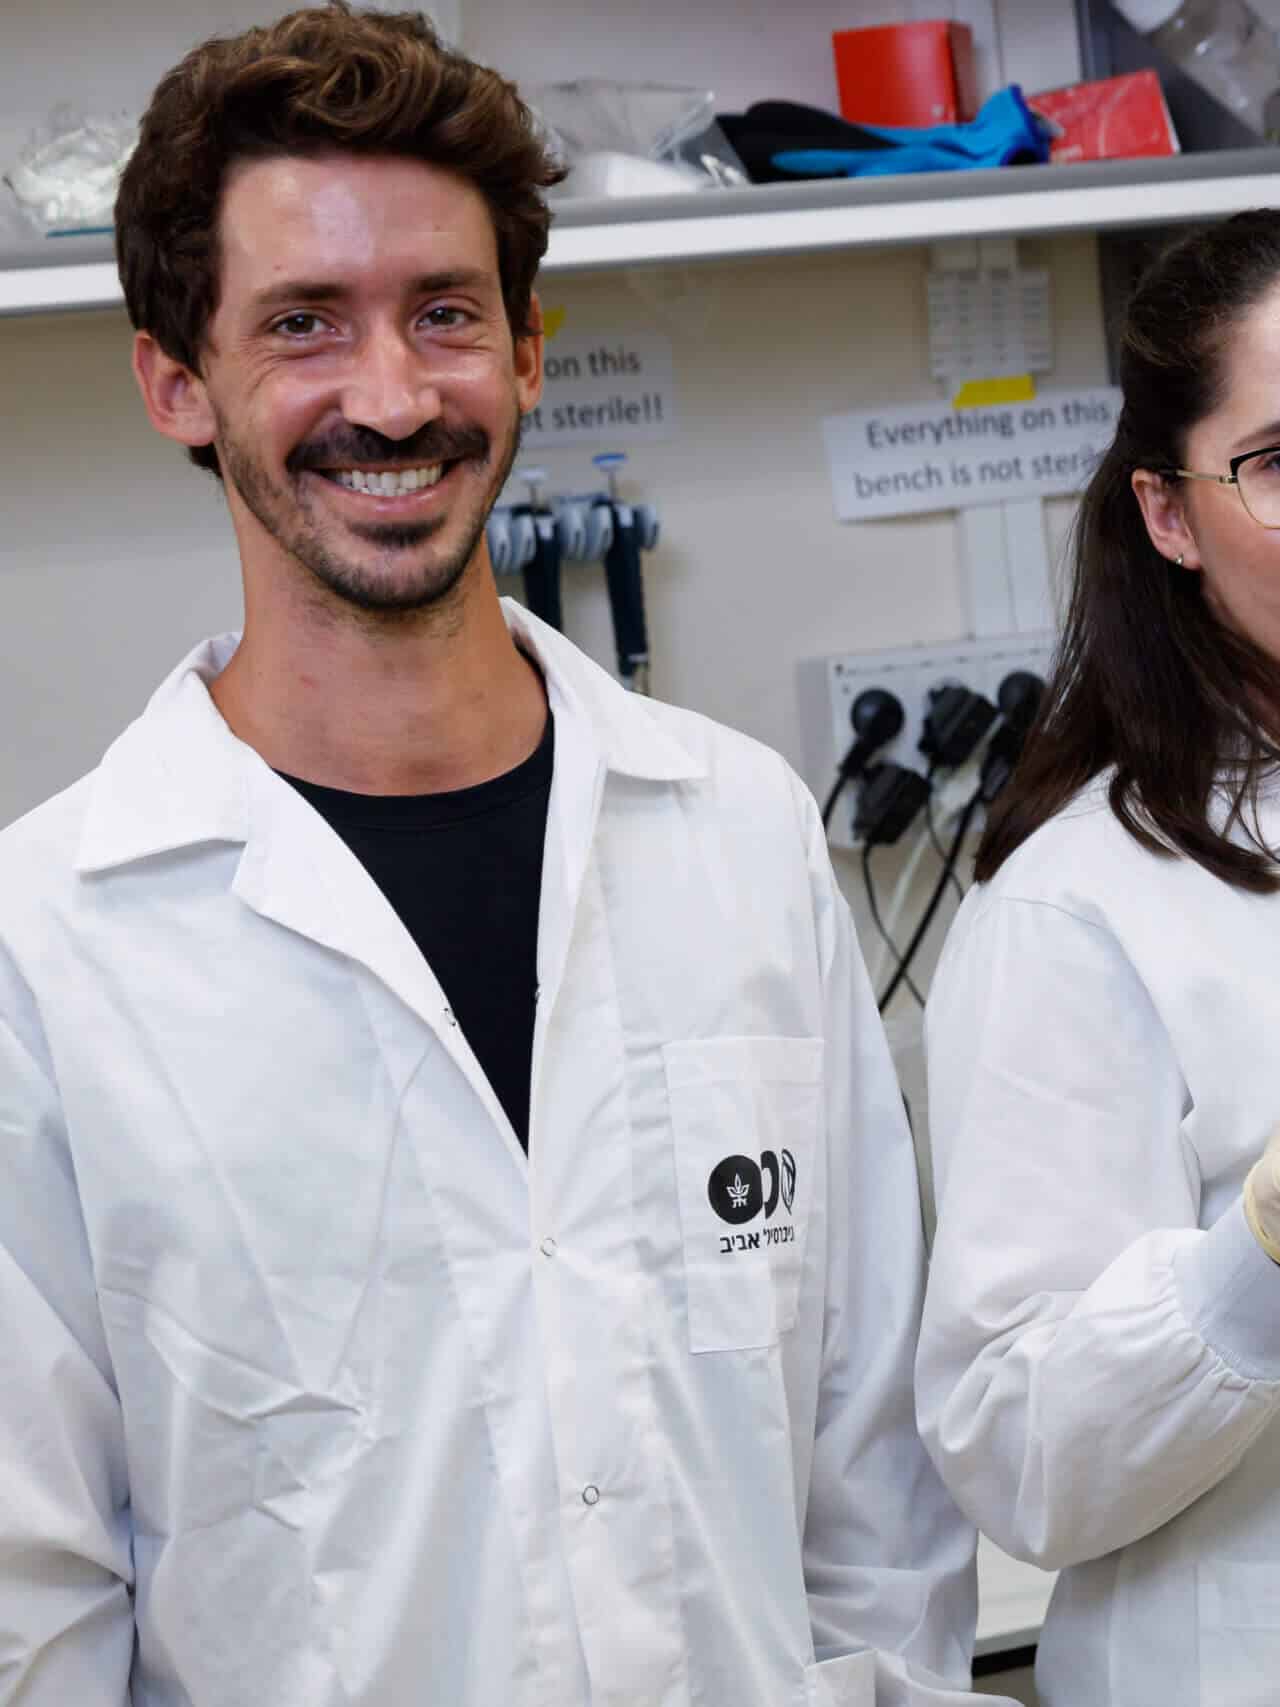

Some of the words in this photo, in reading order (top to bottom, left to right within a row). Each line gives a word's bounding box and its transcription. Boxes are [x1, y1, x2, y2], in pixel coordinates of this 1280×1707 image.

[545, 357, 580, 379] on
[588, 345, 642, 376] this
[552, 392, 664, 430] sterile!!
[865, 408, 1015, 449] Everything
[1021, 404, 1056, 430] on
[1063, 398, 1111, 425] this
[854, 462, 943, 498] bench
[951, 460, 973, 486] is
[978, 455, 1023, 484] not
[719, 1232, 760, 1254] אביב
